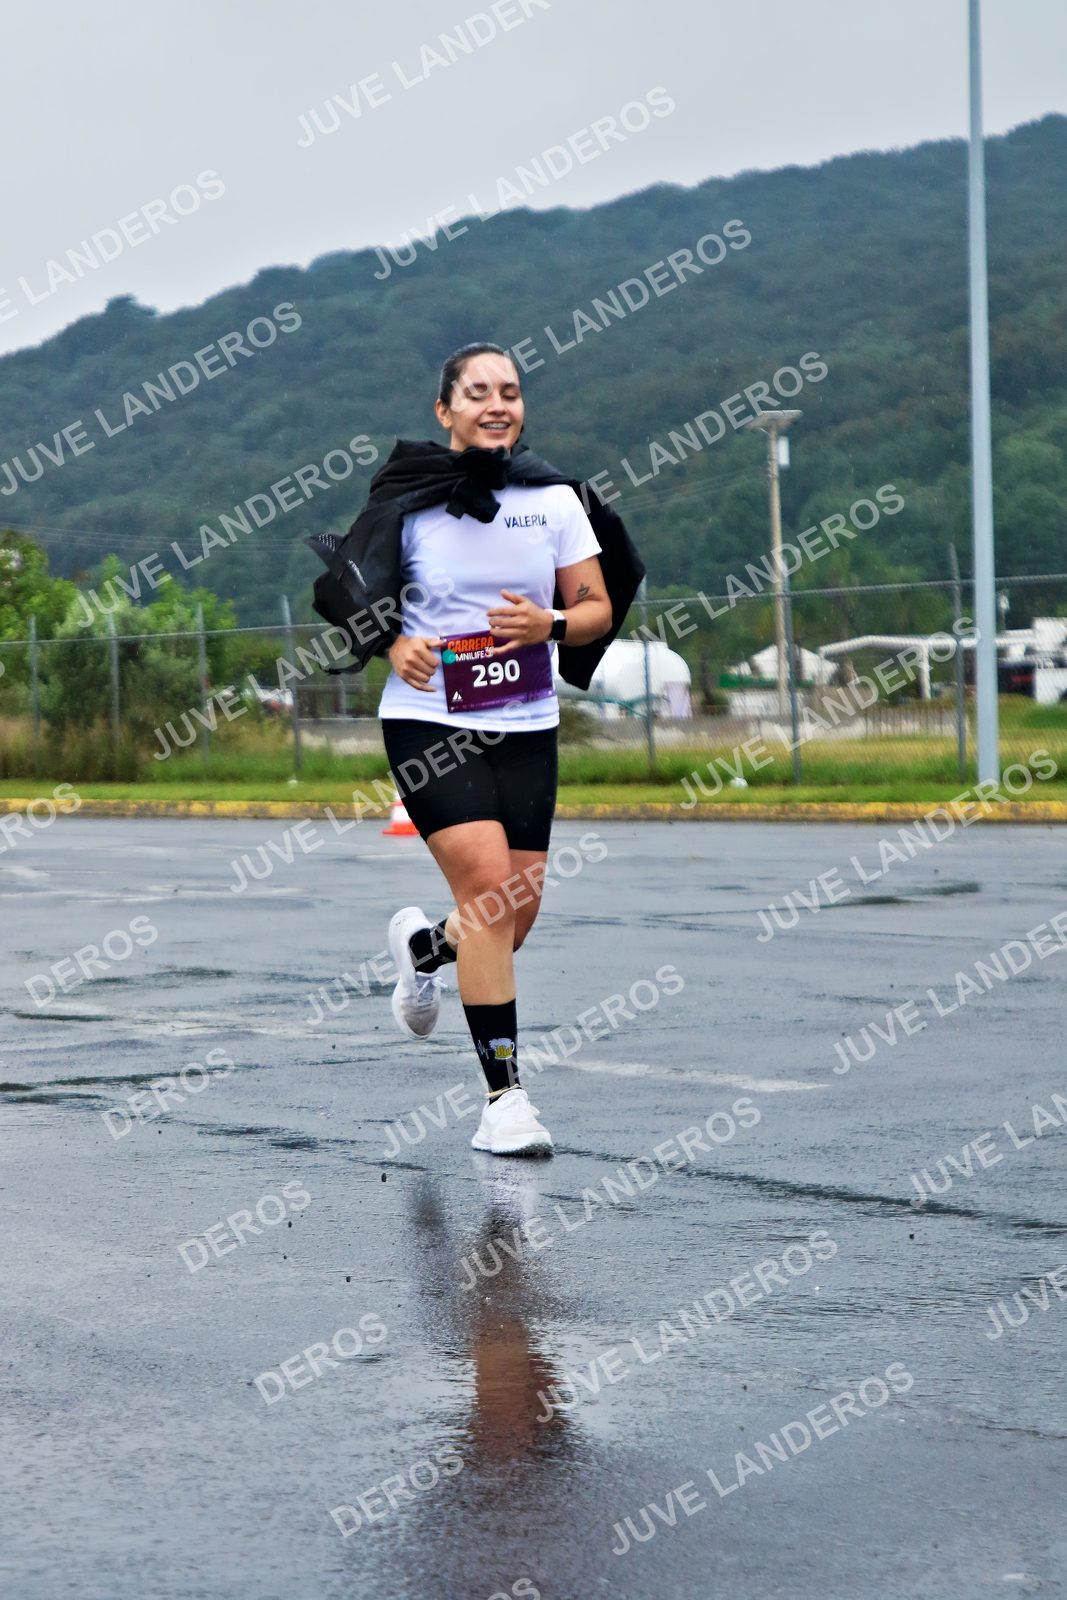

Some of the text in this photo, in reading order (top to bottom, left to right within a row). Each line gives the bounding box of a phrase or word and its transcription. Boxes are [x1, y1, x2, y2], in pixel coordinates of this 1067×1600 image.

[504, 514, 547, 528] VALERIA
[447, 636, 494, 652] CARRERA
[471, 659, 520, 687] 290
